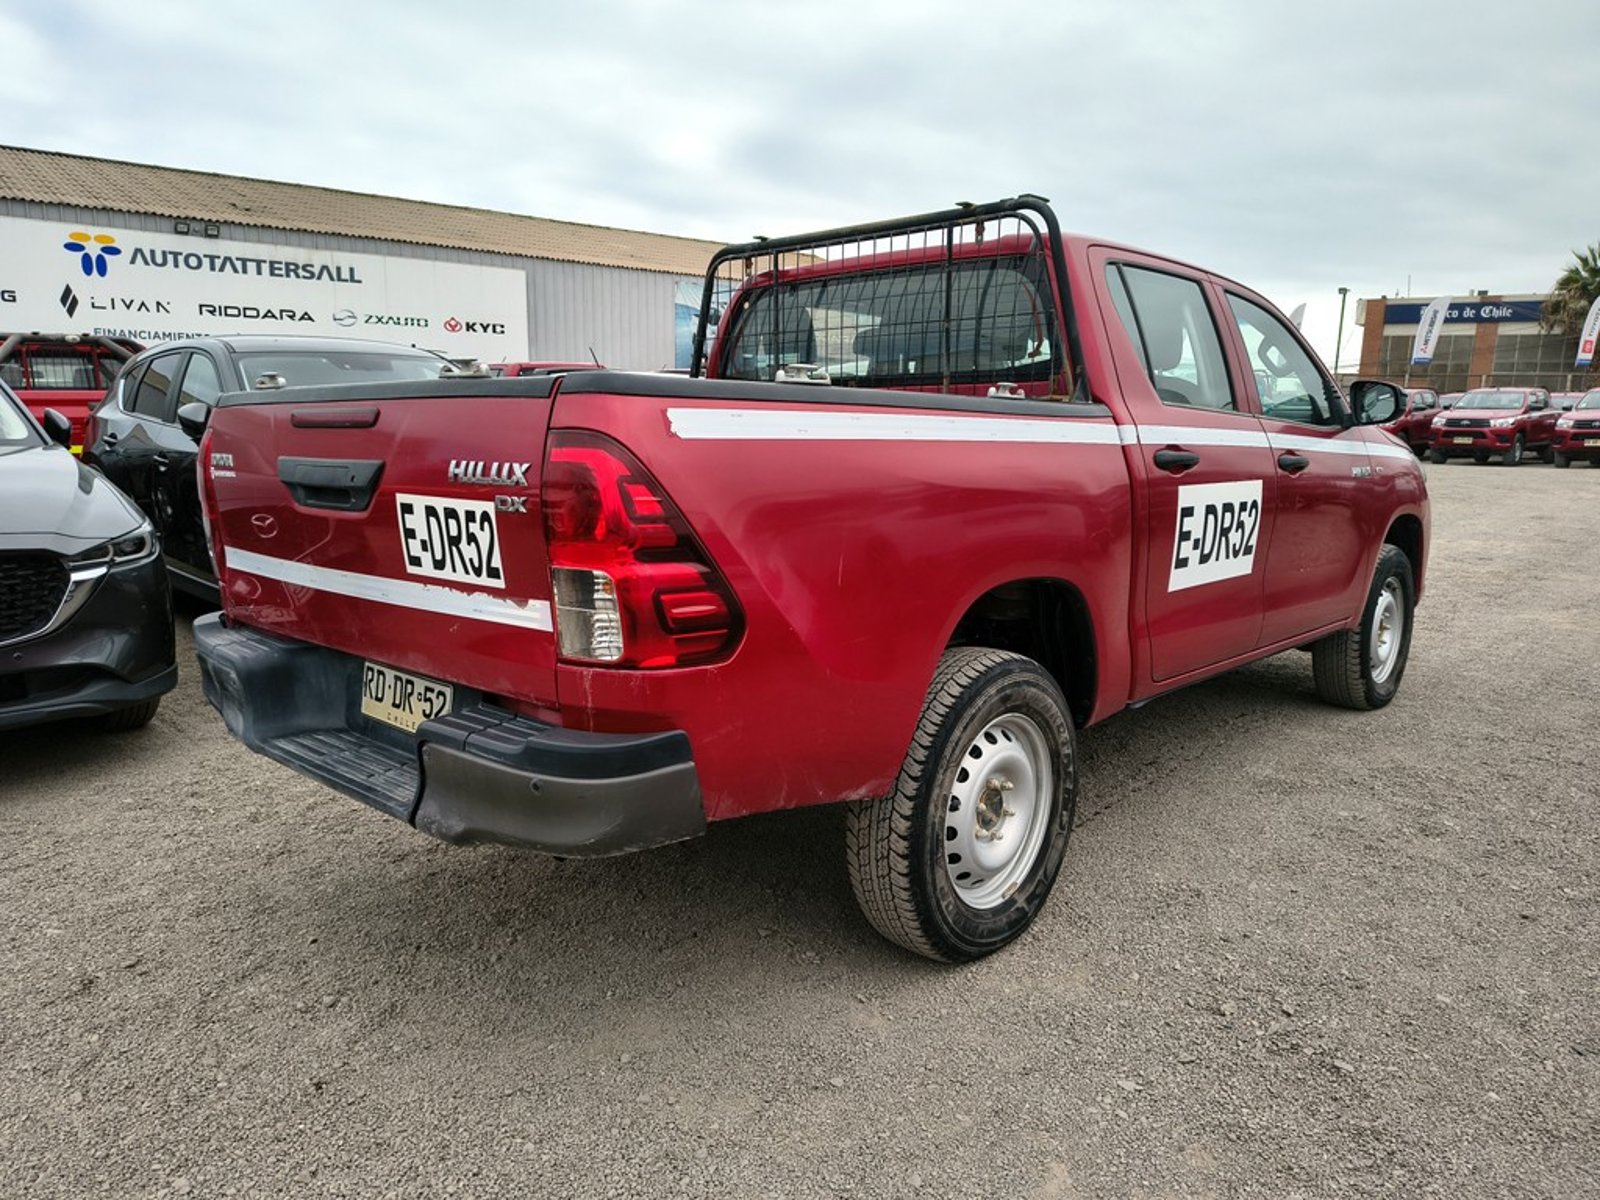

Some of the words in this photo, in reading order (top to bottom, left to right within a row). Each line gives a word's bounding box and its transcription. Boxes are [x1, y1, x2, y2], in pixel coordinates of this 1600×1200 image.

[129, 247, 363, 284] AUTOTATTERSALL
[90, 296, 171, 314] LIVAN
[199, 303, 316, 323] RIDDARA
[1462, 306, 1476, 318] de
[1480, 305, 1513, 319] Chile
[364, 314, 429, 328] ZXAUTO
[465, 321, 505, 335] KYC
[93, 327, 211, 342] FINANCIAMIEN
[448, 459, 531, 487] HILUX
[495, 494, 528, 513] DX
[399, 502, 502, 580] E-DR52
[1174, 498, 1259, 570] E-DR52
